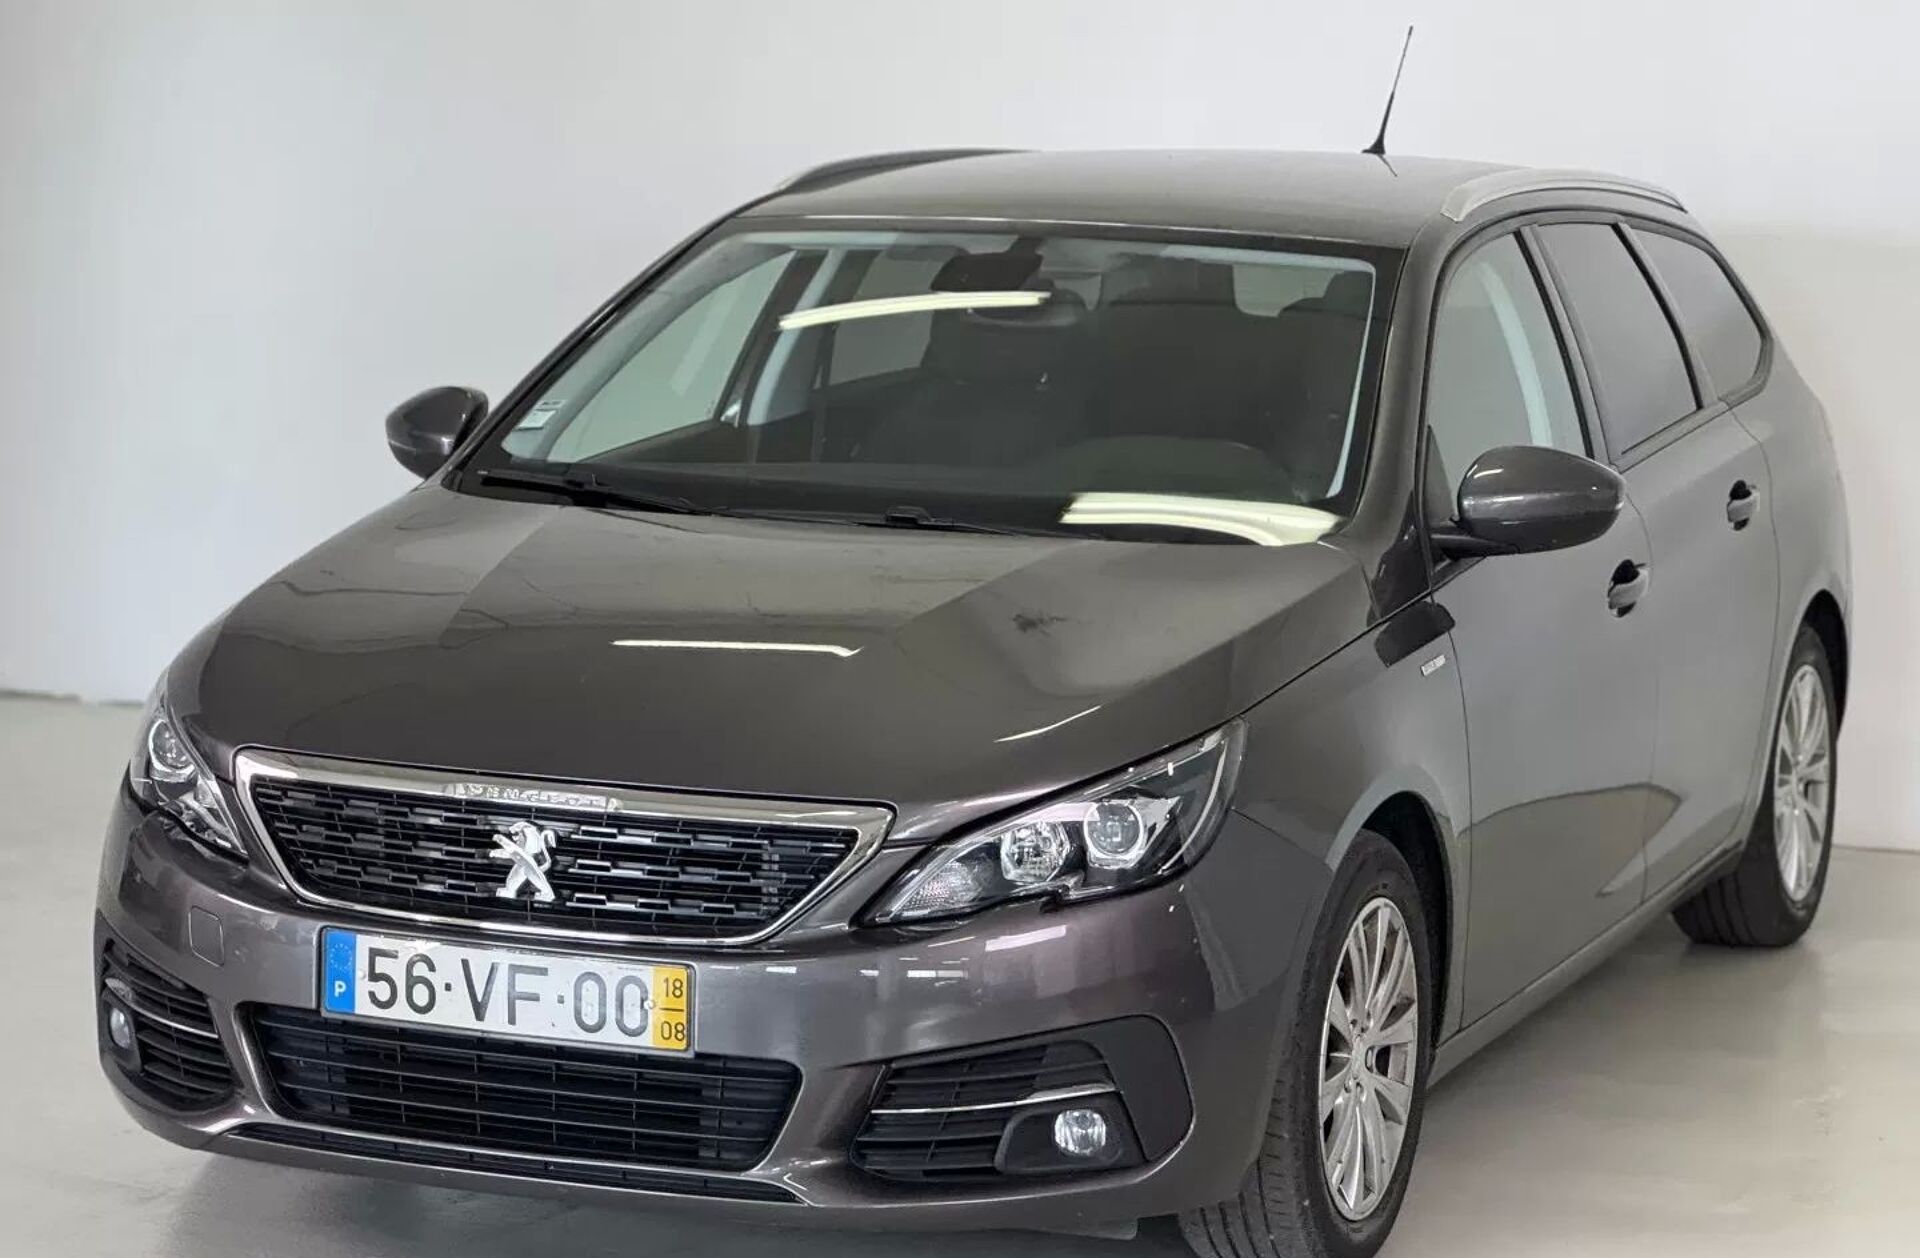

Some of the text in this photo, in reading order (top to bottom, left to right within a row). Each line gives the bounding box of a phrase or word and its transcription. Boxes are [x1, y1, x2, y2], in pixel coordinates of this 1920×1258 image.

[334, 981, 347, 997] P
[663, 977, 684, 998] 18
[660, 1020, 685, 1041] 08
